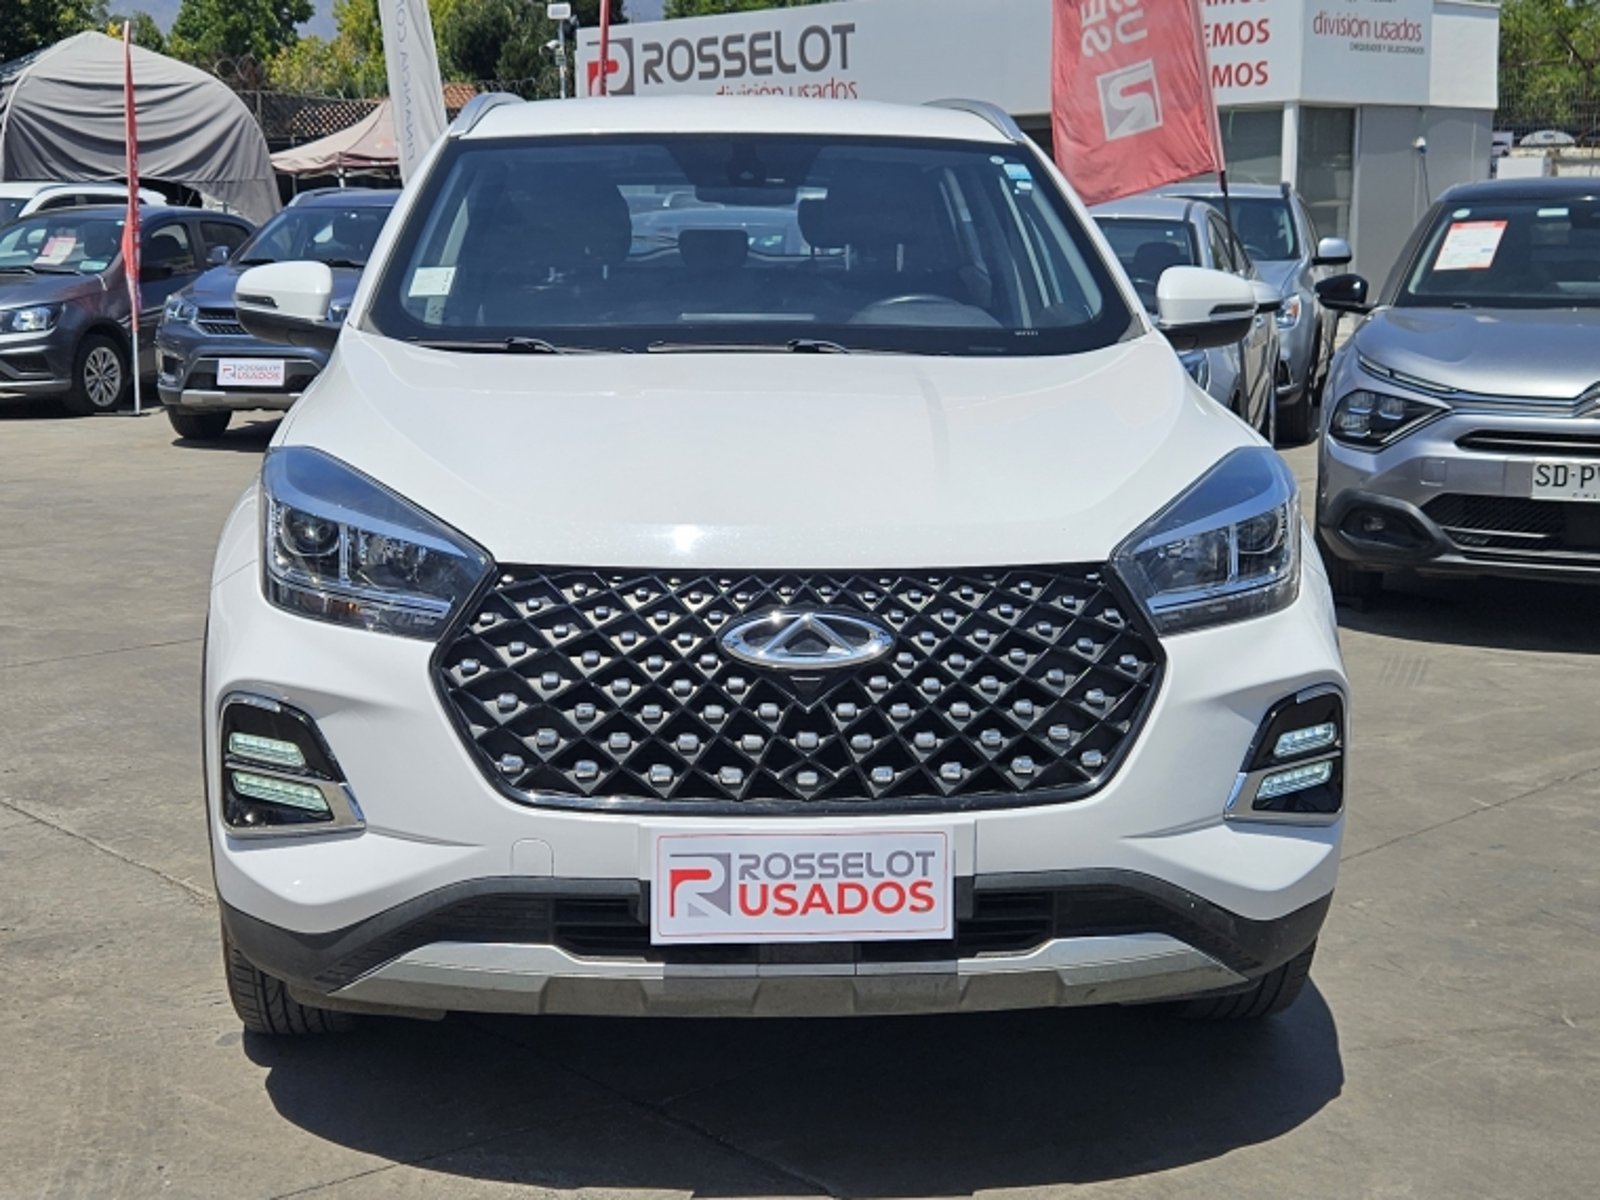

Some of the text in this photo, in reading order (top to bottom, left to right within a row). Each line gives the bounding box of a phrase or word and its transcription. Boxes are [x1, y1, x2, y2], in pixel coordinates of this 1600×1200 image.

[1313, 9, 1422, 42] división usados
[642, 23, 856, 85] ROSSELOT
[738, 851, 936, 880] ROSSELOT
[738, 880, 936, 917] USADOS
